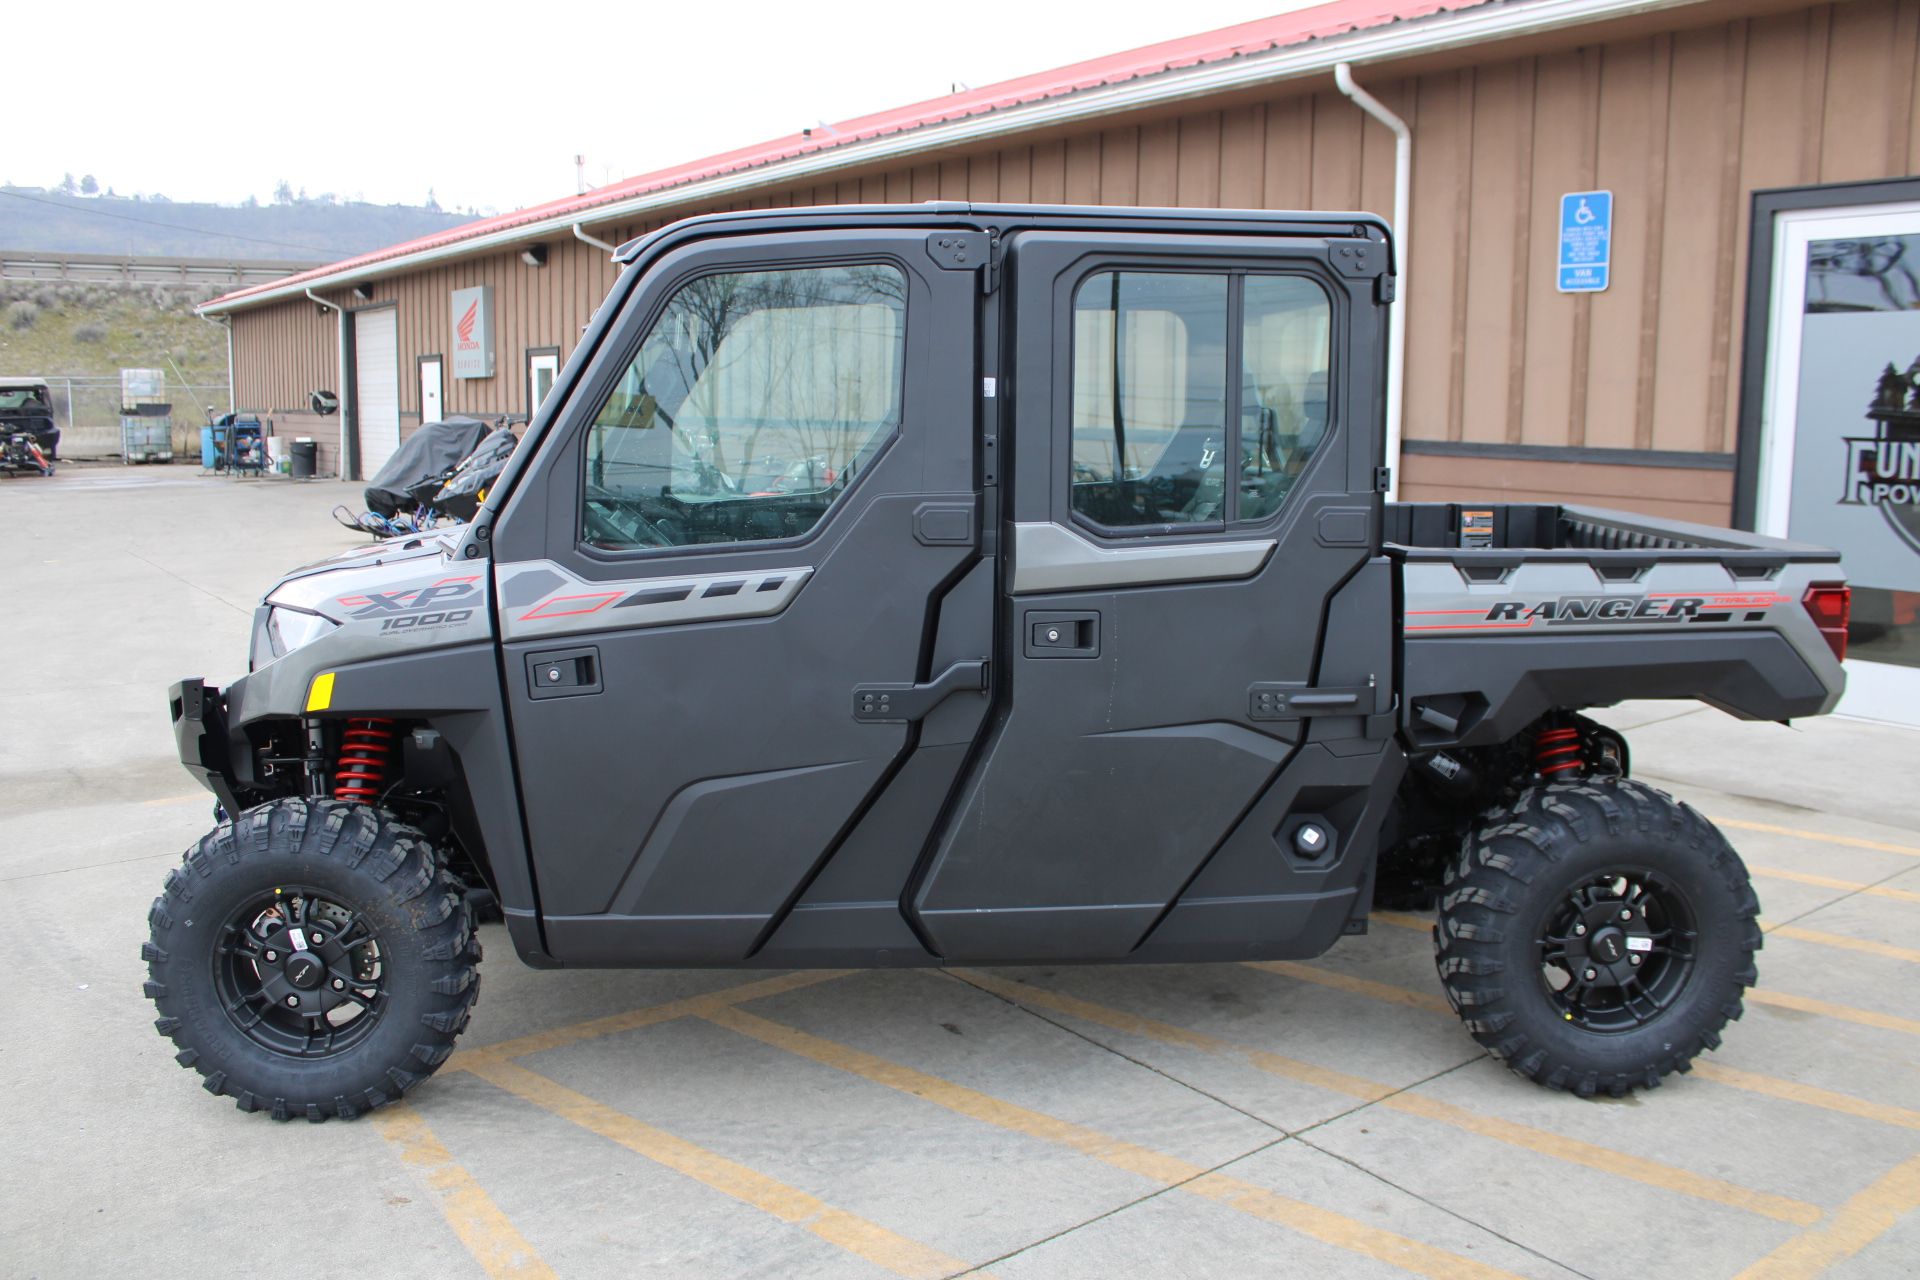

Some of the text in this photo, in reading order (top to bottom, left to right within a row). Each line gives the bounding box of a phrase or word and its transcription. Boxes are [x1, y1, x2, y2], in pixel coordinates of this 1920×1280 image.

[1575, 268, 1592, 277] VAN
[457, 341, 480, 351] HONDA
[350, 583, 474, 615] XP
[1485, 598, 1704, 621] RANGER
[381, 609, 473, 630] 1000
